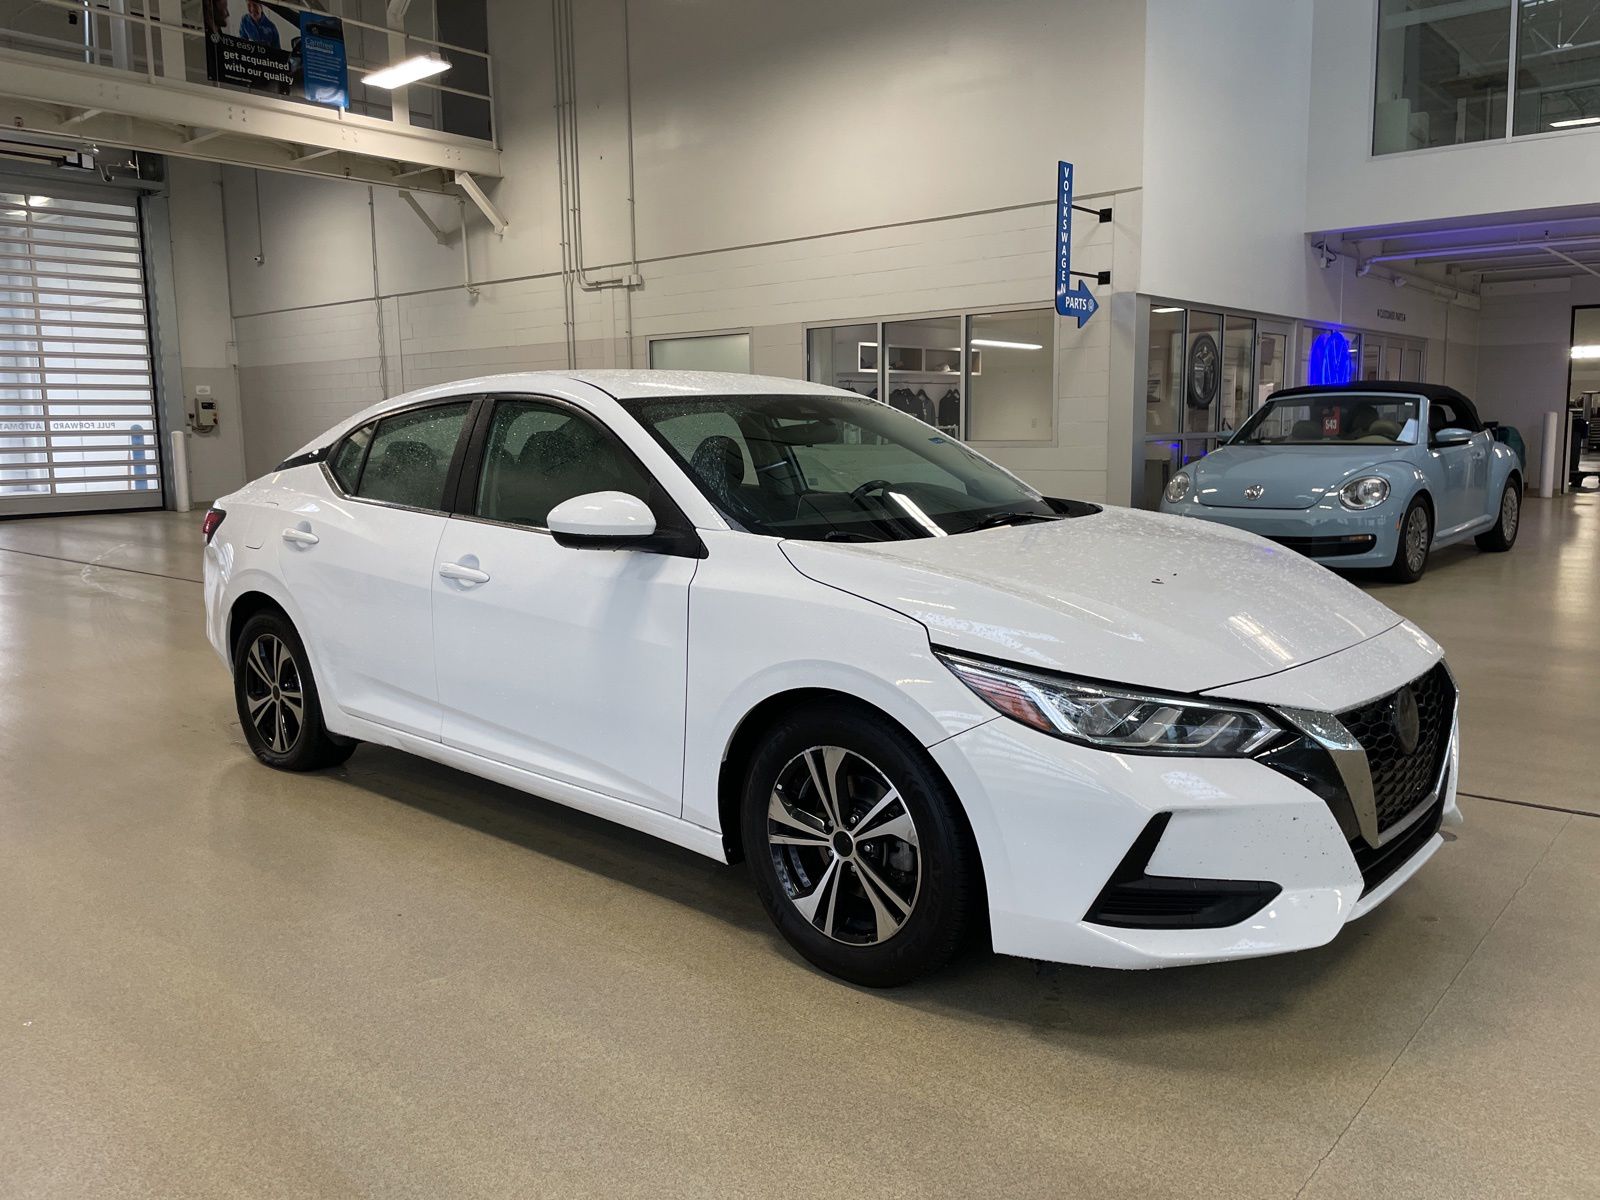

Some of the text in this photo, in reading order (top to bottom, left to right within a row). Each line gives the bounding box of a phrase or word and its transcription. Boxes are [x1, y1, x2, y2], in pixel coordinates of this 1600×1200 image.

[237, 42, 255, 53] easy
[258, 45, 266, 54] to
[224, 51, 290, 71] get acquainted
[224, 63, 246, 73] with
[247, 68, 262, 77] our
[263, 71, 294, 85] quality
[1060, 166, 1070, 294] VOLKSWAGEN
[1065, 296, 1087, 311] PARTS
